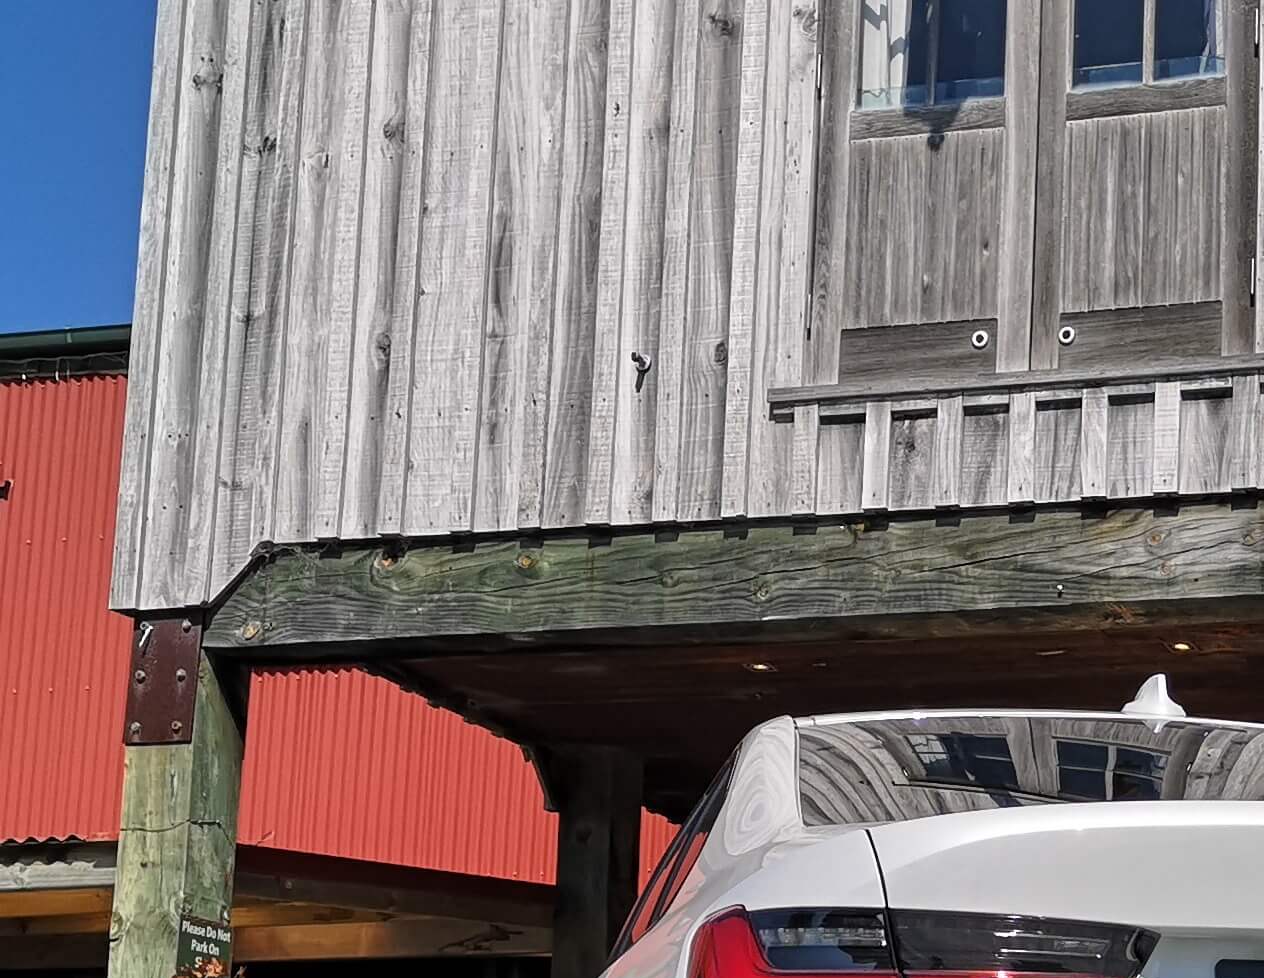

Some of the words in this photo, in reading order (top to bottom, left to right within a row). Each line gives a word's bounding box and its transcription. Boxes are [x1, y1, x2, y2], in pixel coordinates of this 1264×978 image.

[181, 920, 206, 937] Please
[206, 926, 217, 939] Do
[217, 929, 231, 943] Not
[191, 939, 208, 954] Park
[208, 943, 220, 956] On
